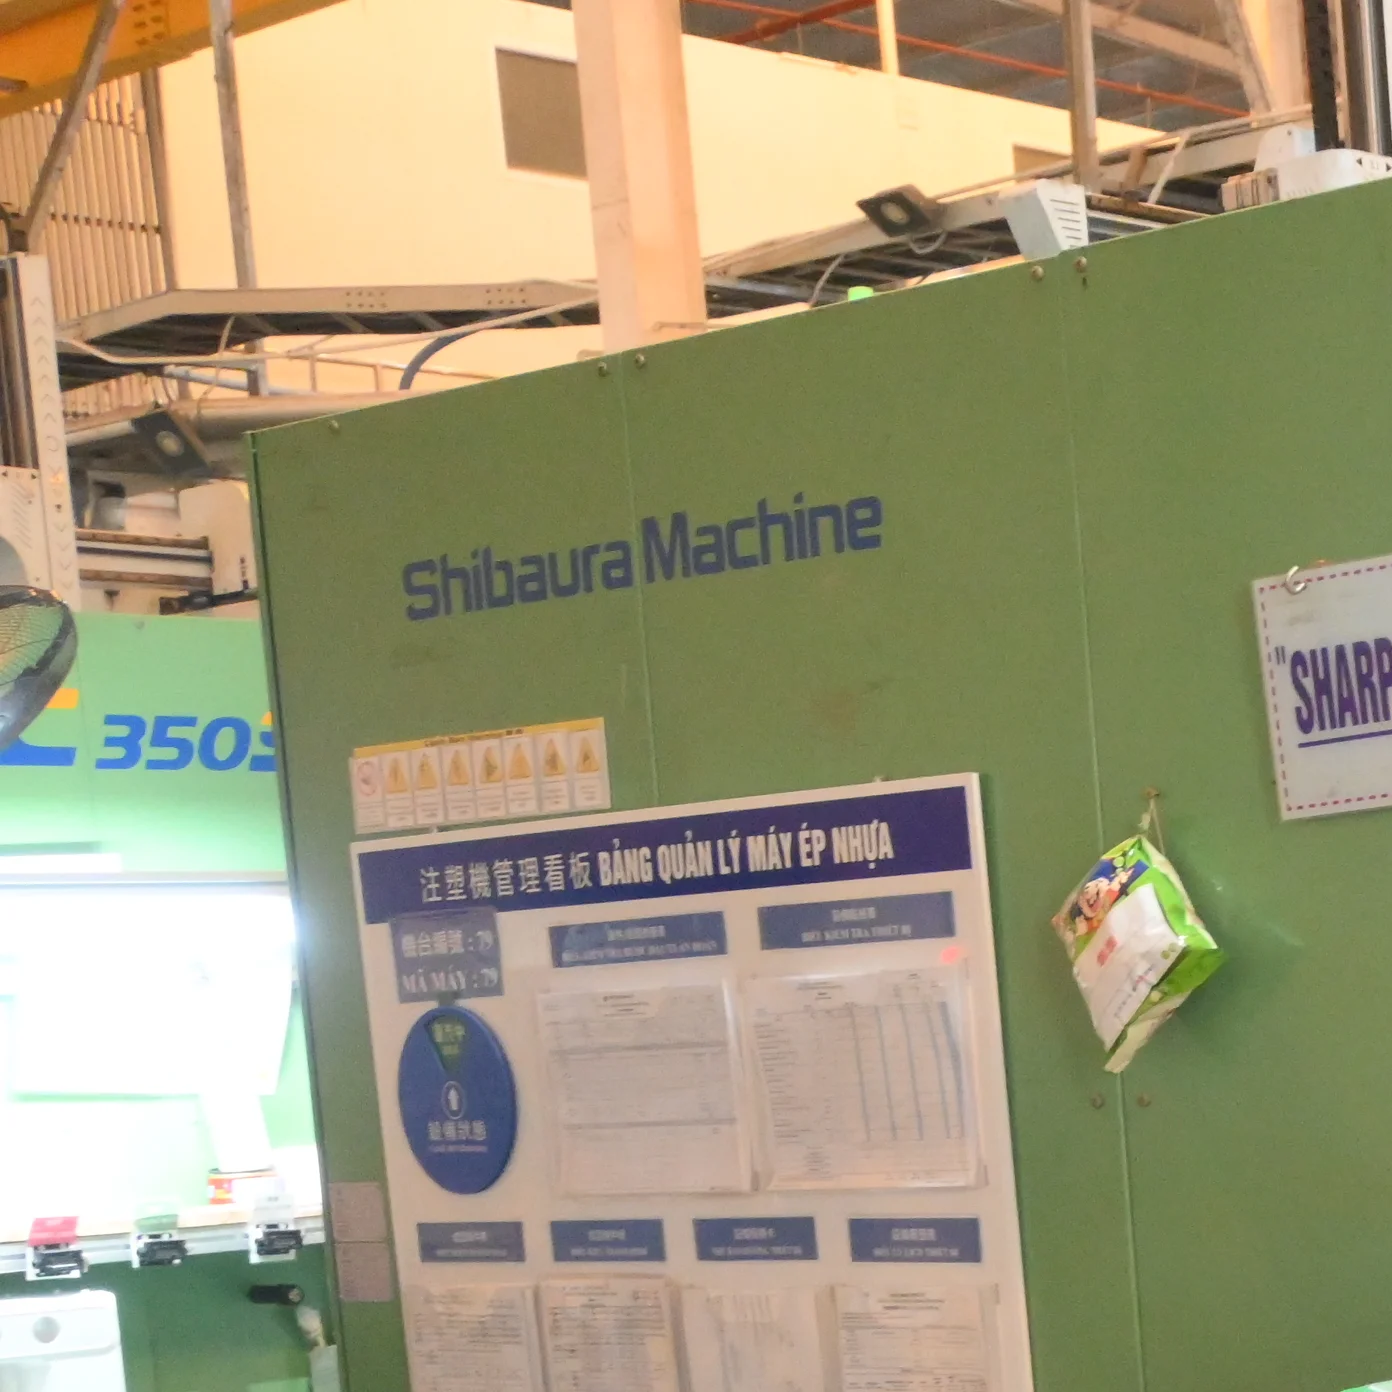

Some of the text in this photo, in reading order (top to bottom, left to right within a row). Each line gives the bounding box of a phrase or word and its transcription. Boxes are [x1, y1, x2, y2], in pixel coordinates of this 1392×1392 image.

[402, 492, 884, 621] Shibaura Machine
[420, 819, 894, 903] 注塑機管理看板 BẢNG QUẢN LÝ MÁY ÉP NHỰA
